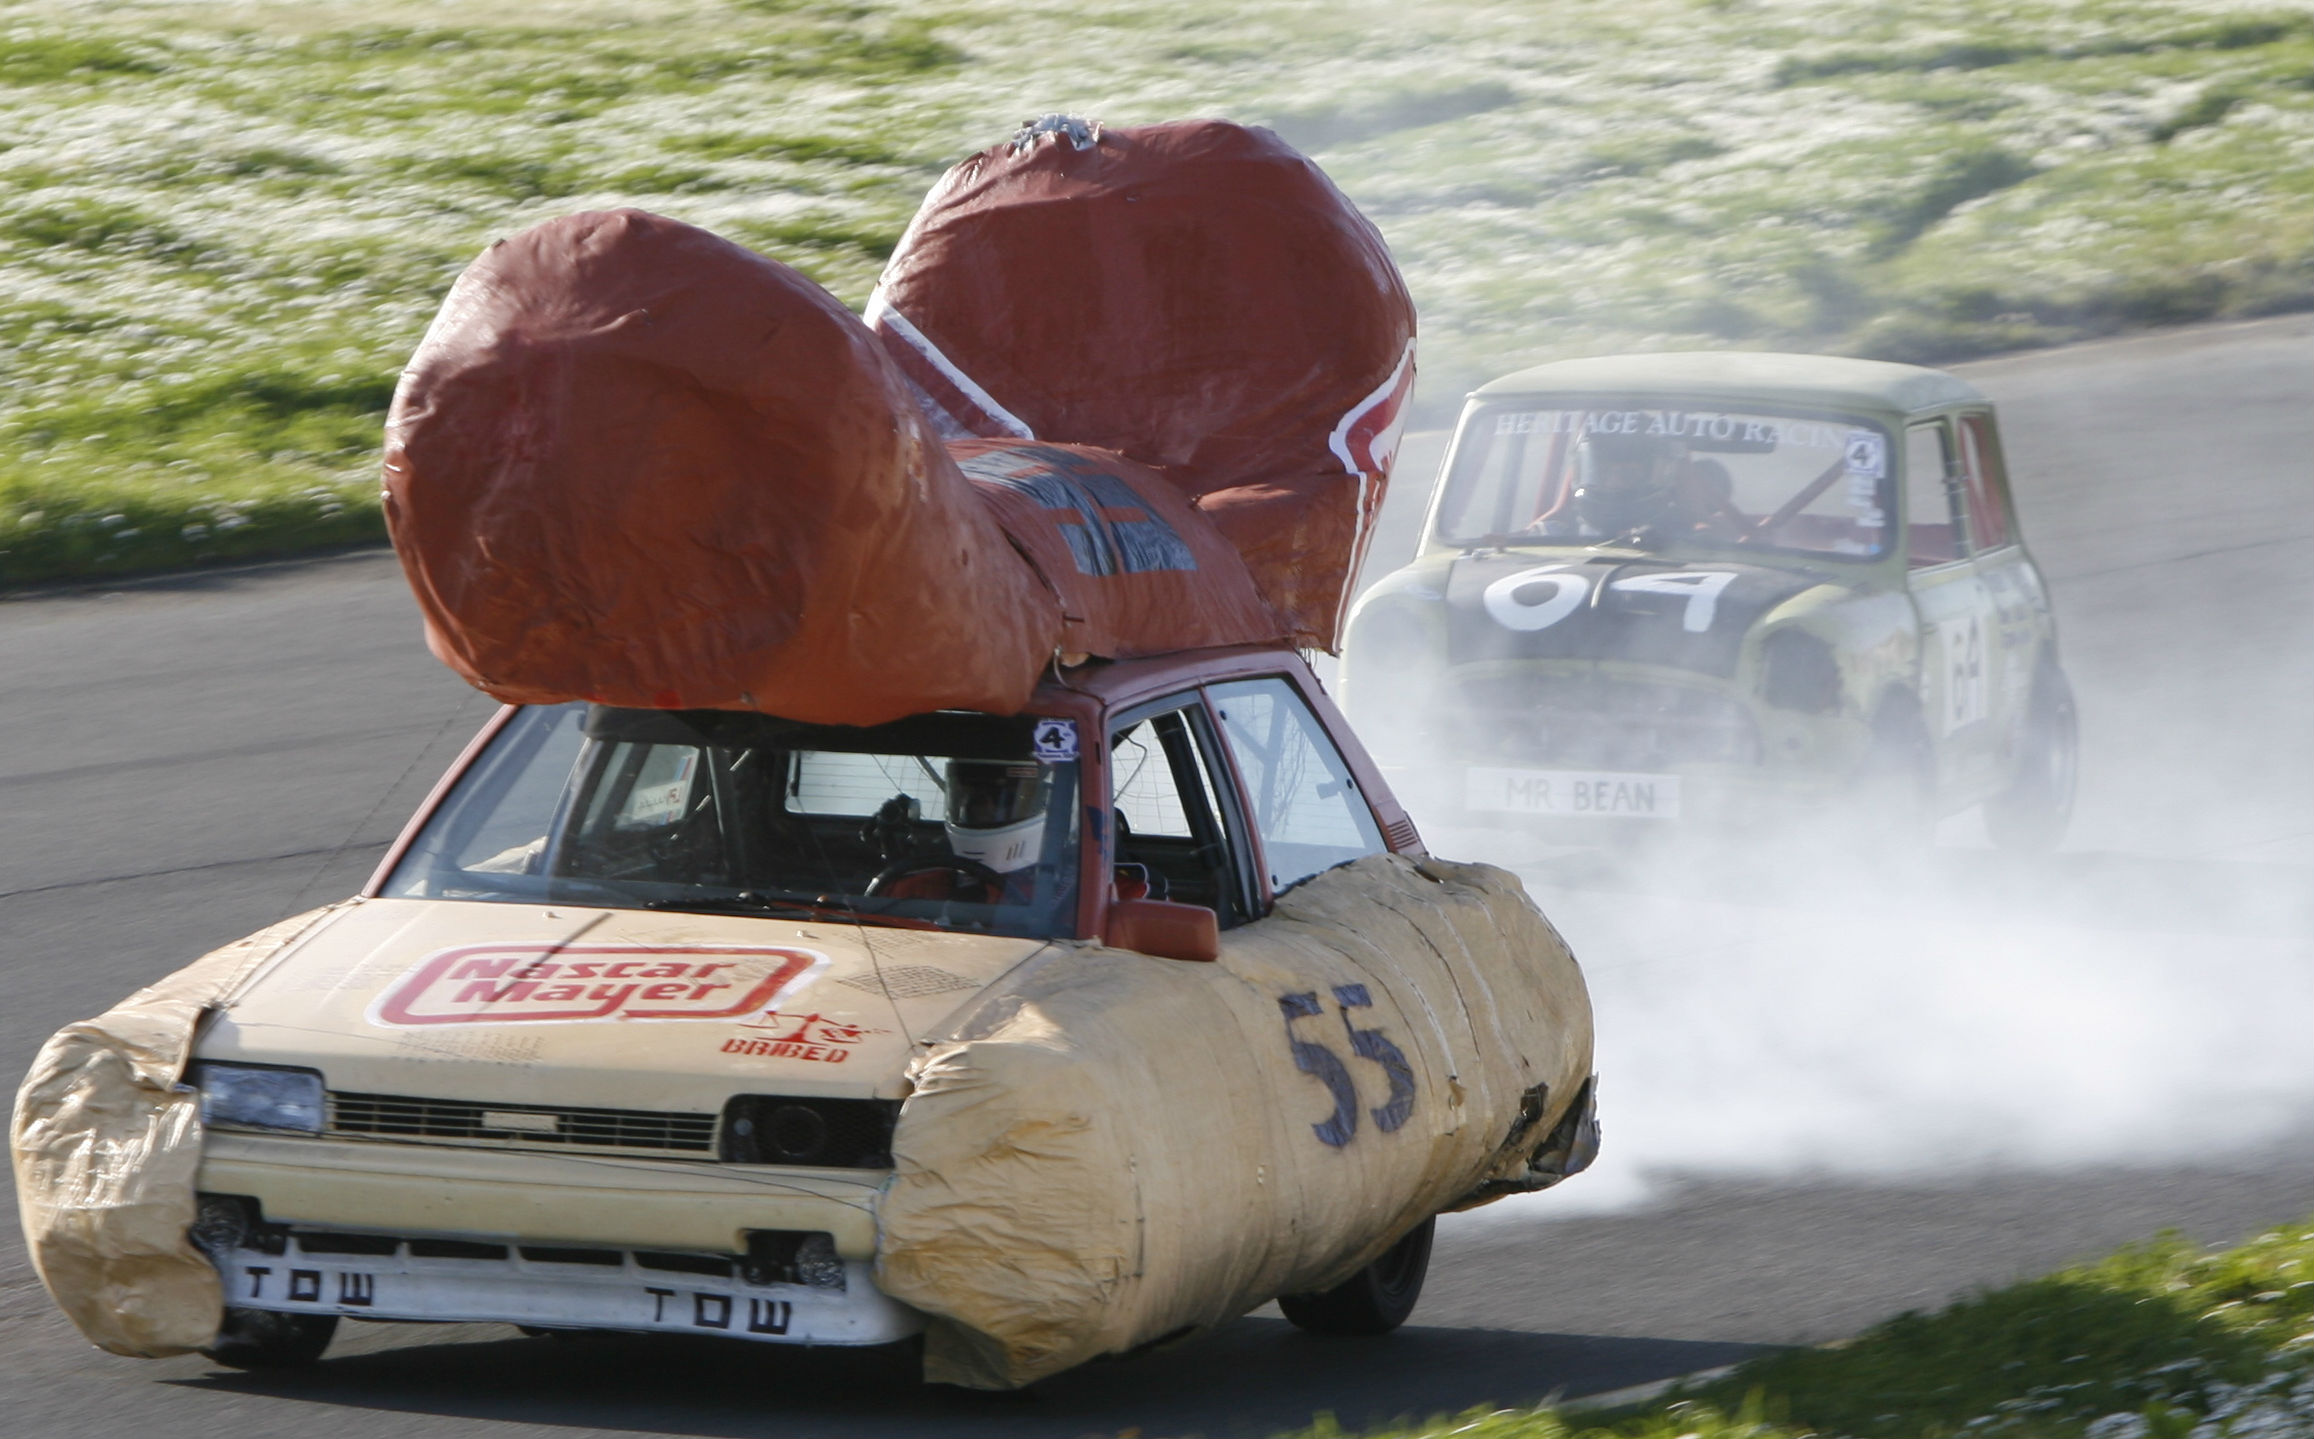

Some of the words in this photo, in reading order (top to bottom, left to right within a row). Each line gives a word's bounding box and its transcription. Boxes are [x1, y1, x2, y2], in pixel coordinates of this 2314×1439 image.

[1494, 410, 1641, 435] HERITAGE
[1644, 410, 1736, 439] AUTO
[1743, 421, 1846, 449] RACIN
[1483, 564, 1739, 633] 64
[1040, 726, 1066, 749] 4
[1504, 777, 1553, 810] MR
[1572, 780, 1655, 812] BEAN
[446, 958, 738, 980] Nascar
[451, 980, 733, 1014] Mayer
[719, 1038, 850, 1064] BRIBED
[1277, 983, 1416, 1148] 55
[245, 1266, 373, 1306] TOW
[644, 1286, 792, 1336] TOW
